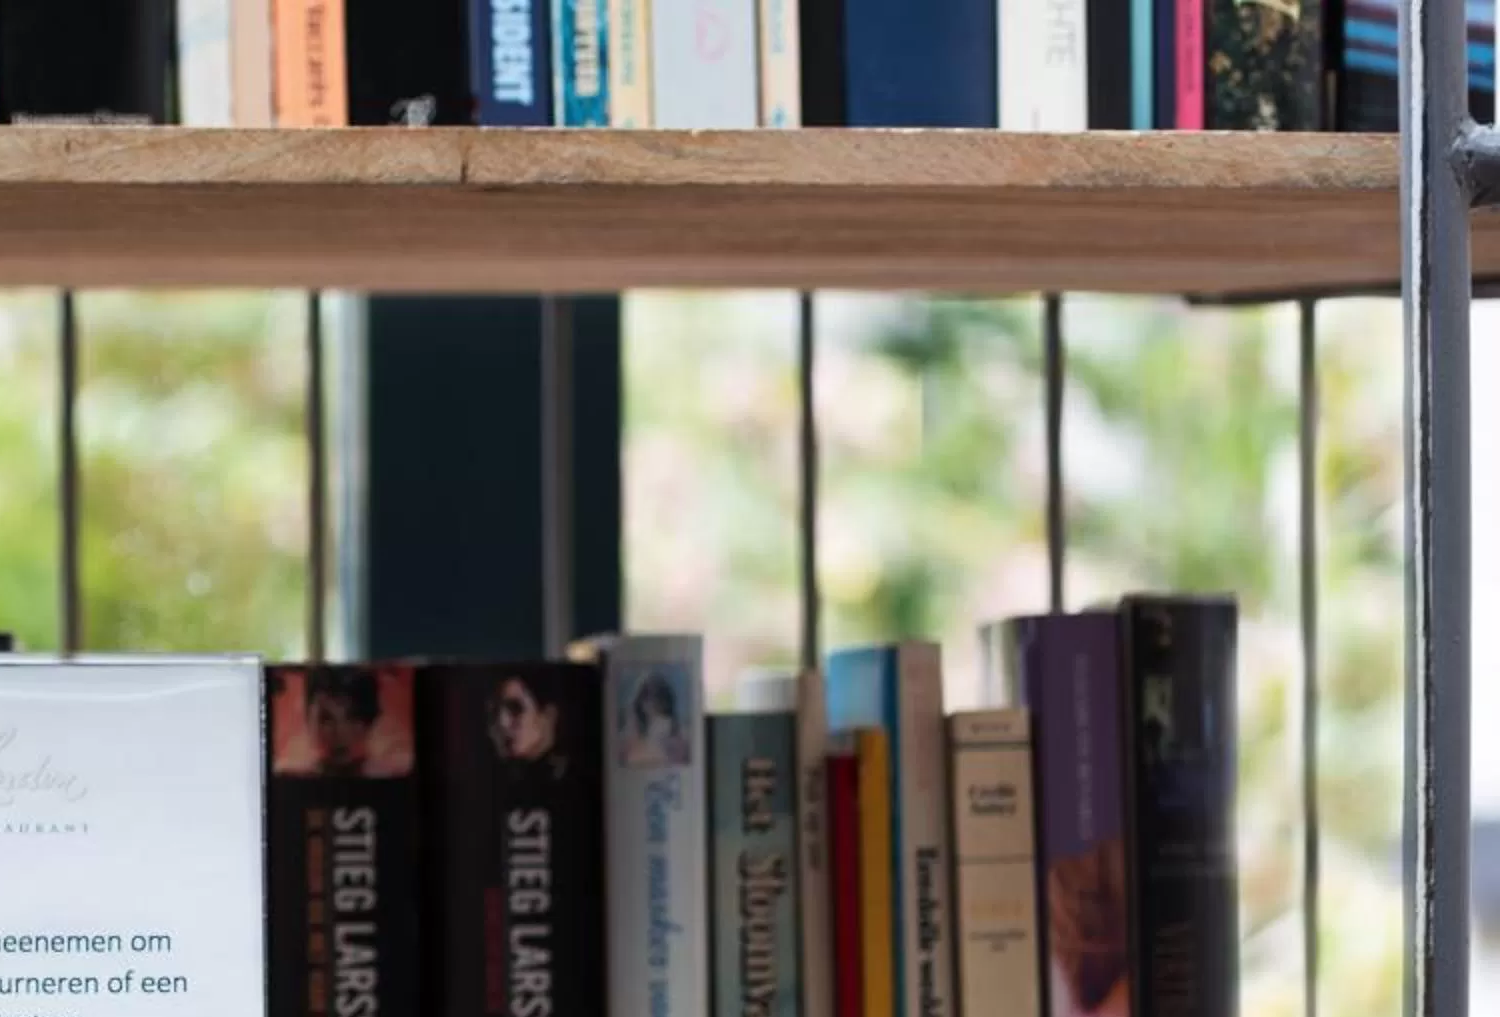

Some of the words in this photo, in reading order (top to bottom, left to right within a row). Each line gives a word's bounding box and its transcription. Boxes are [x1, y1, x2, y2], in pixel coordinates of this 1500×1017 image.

[333, 807, 379, 912] STIEG
[507, 808, 551, 914] STIEG
[130, 934, 172, 953] om
[107, 968, 135, 995] of
[140, 975, 188, 995] een
